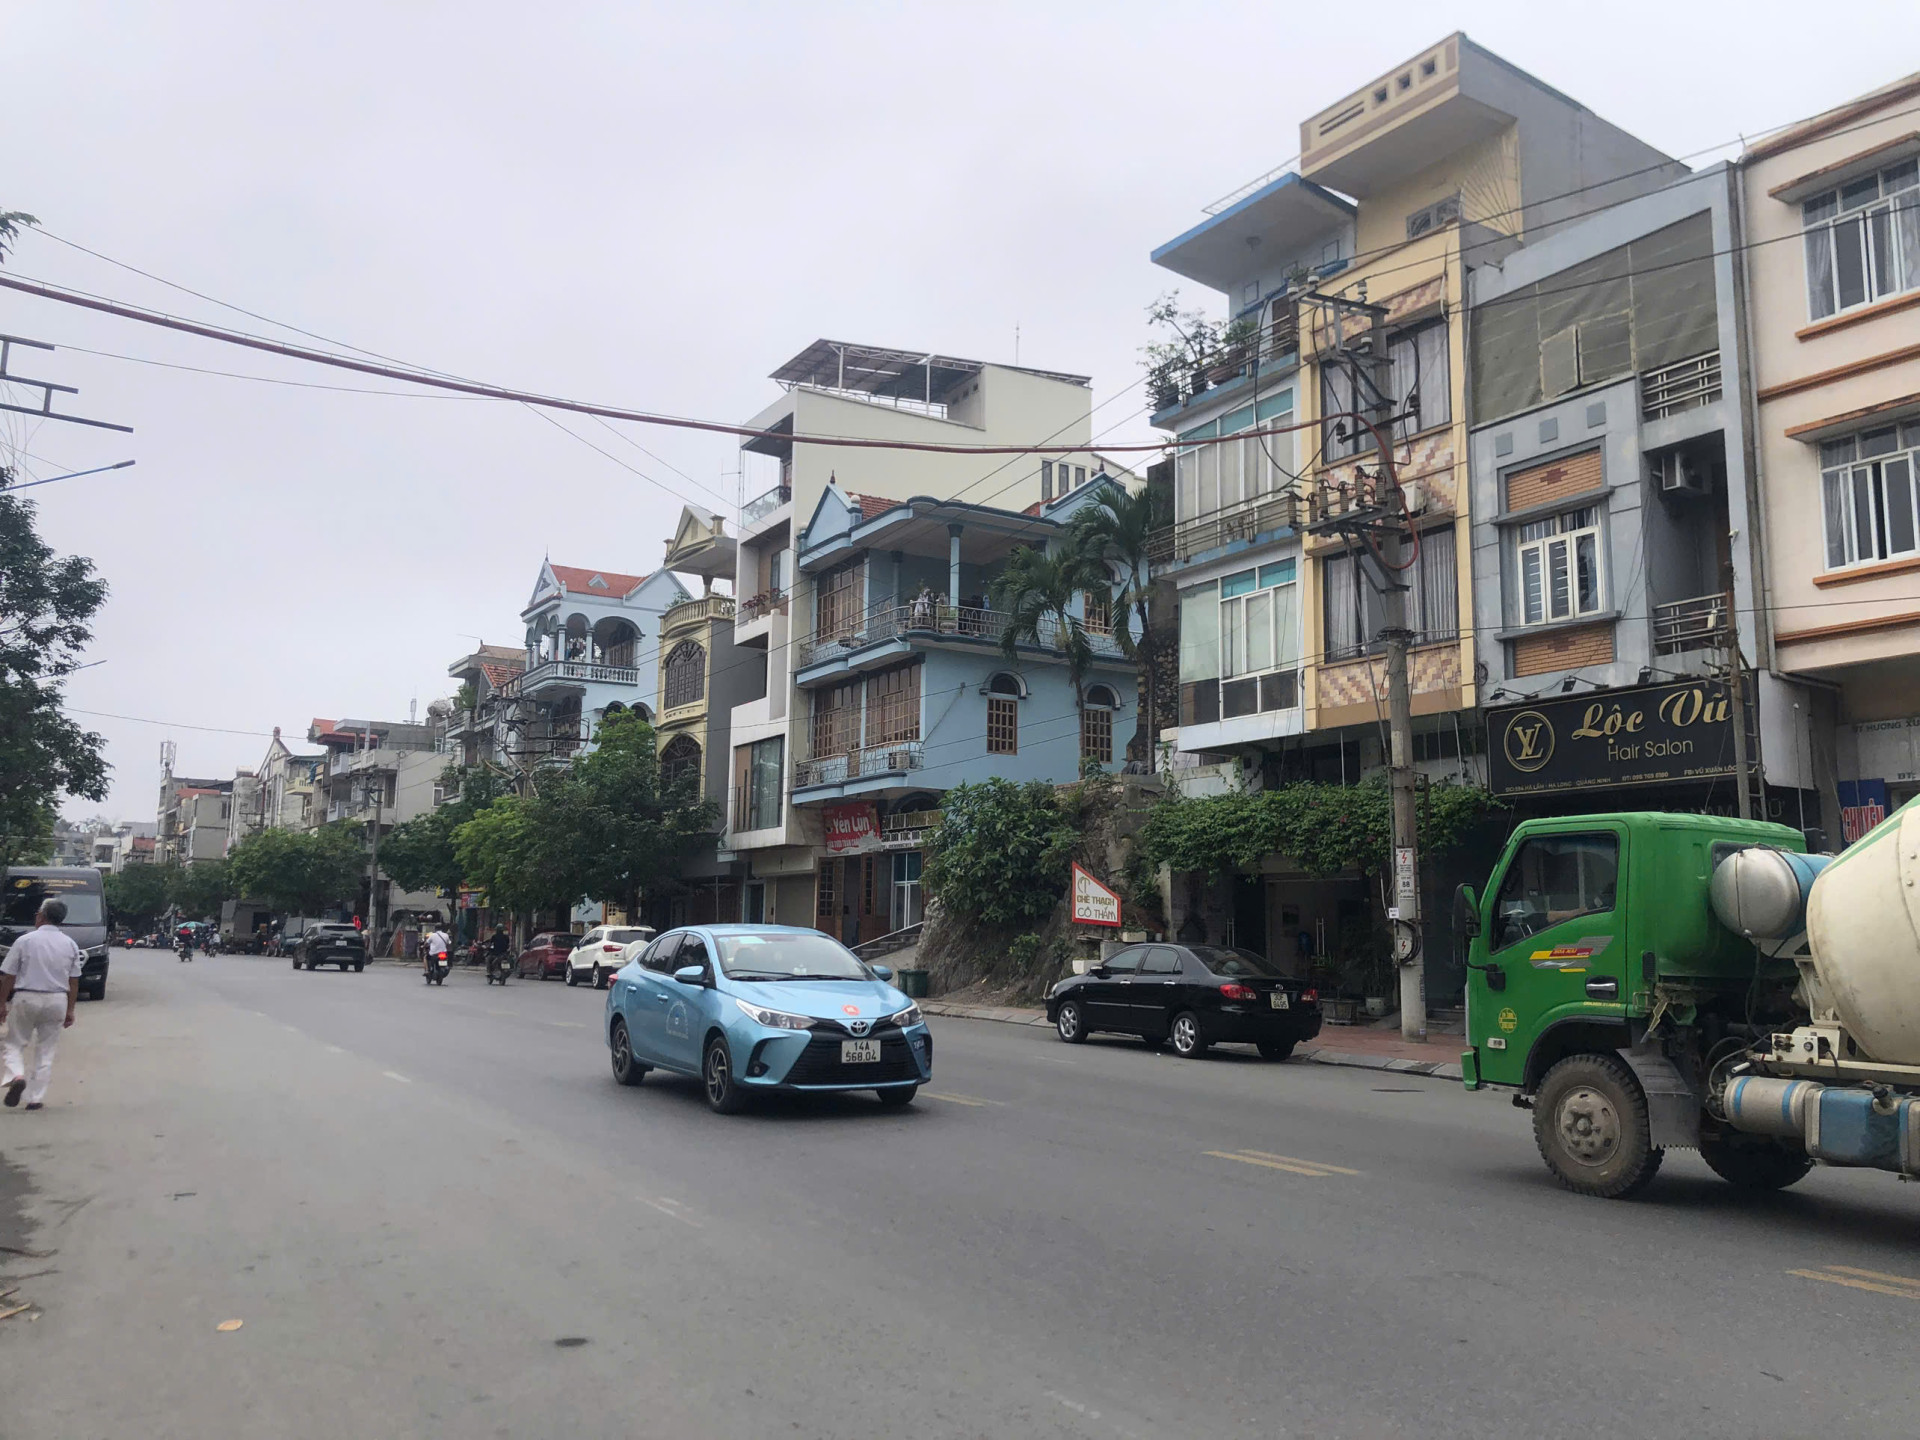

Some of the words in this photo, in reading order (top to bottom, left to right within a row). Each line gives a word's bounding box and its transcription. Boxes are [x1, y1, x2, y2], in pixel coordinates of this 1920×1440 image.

[1571, 703, 1645, 744] Lộc
[1658, 689, 1733, 727] Vũ
[1608, 743, 1640, 762] Hair
[1645, 738, 1694, 757] Salon
[1078, 906, 1092, 918] CÔ
[854, 1041, 870, 1050] 14A
[846, 1050, 876, 1061] 568.04
